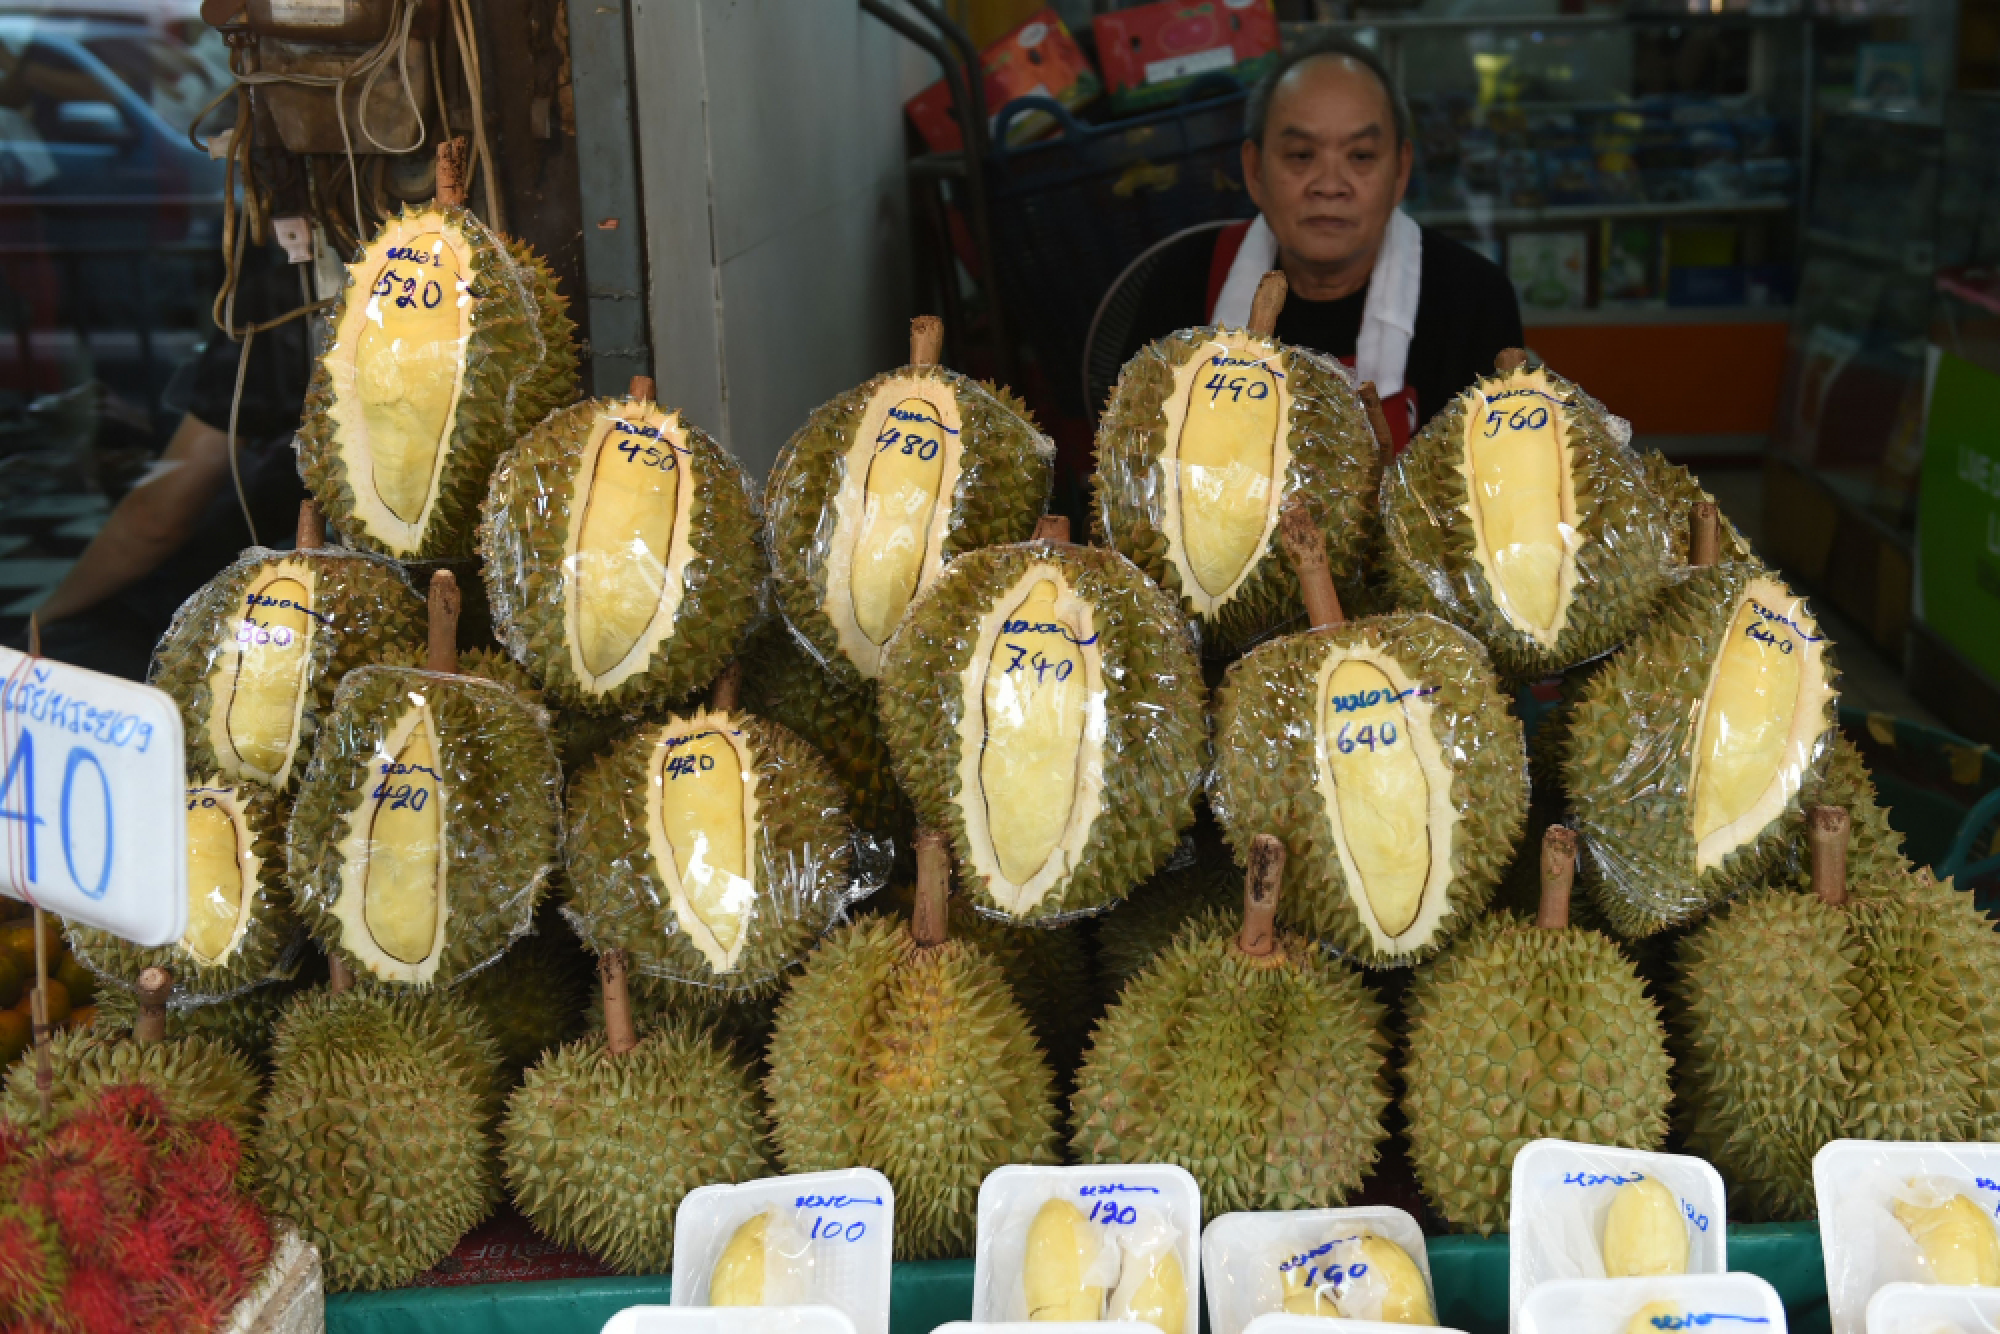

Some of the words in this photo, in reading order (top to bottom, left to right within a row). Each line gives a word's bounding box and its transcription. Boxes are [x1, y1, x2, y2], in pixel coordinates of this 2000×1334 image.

[373, 269, 442, 309] 520
[1204, 373, 1269, 402] 490
[1484, 405, 1549, 438] 560
[617, 440, 677, 472] 450
[876, 428, 939, 461] 480
[1004, 643, 1073, 684] 740
[1337, 720, 1397, 754] 640
[0, 725, 115, 901] 40
[371, 784, 428, 812] 420
[1089, 1199, 1137, 1225] 120
[1680, 1197, 1710, 1233] 120
[811, 1216, 867, 1242] 100
